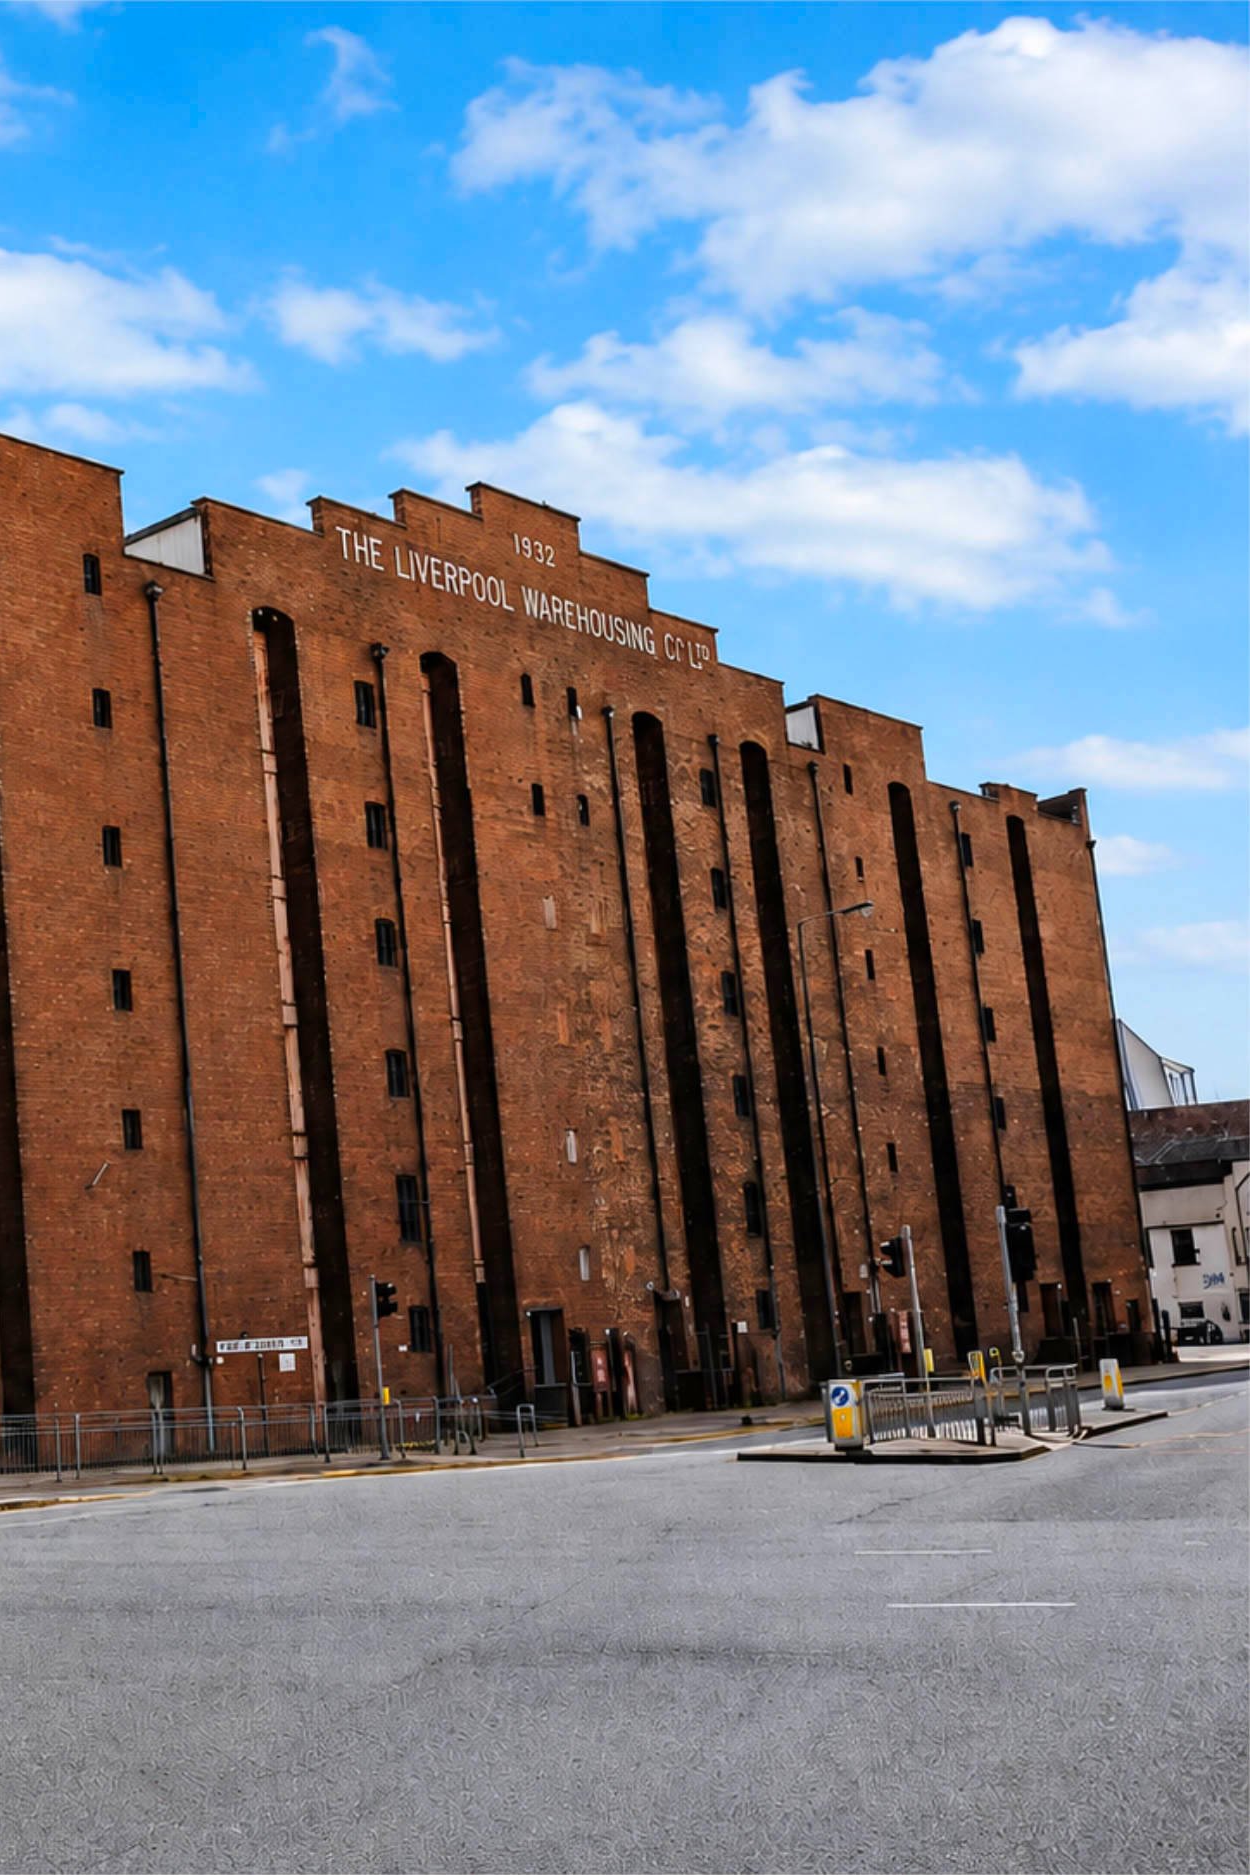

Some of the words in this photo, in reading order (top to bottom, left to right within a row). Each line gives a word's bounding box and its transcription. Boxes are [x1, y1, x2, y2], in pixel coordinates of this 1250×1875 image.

[335, 526, 385, 571] THE
[394, 546, 516, 612] LIVERPOOL
[521, 585, 656, 655] WAREHOUSING
[513, 533, 556, 568] 1932
